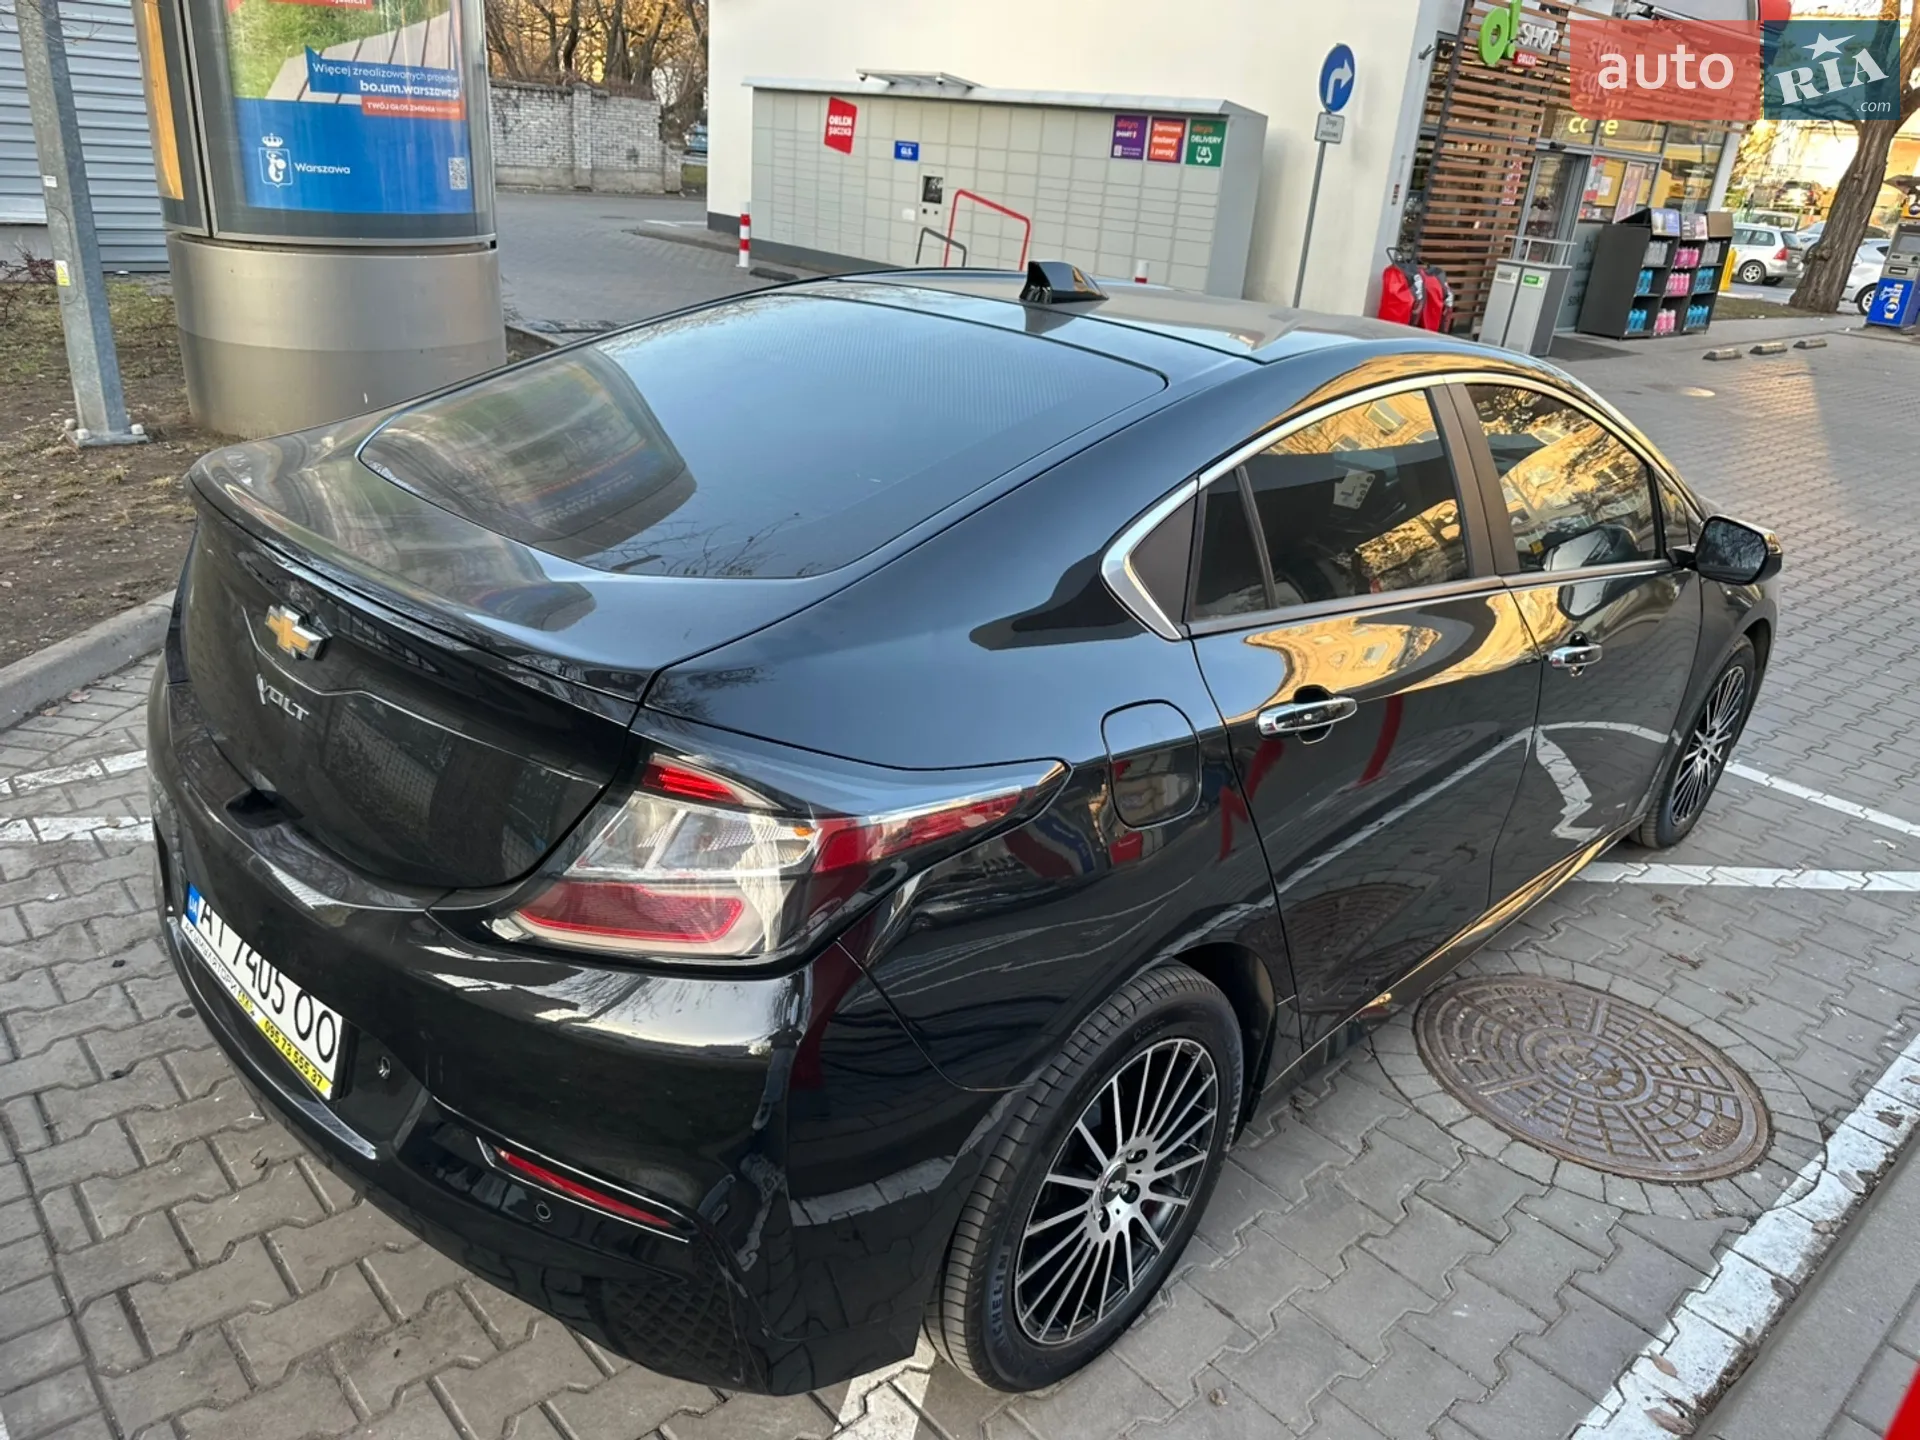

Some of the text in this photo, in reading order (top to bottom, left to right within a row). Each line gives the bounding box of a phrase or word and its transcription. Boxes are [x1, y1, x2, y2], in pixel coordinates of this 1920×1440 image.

[1519, 22, 1560, 55] SHOP
[312, 62, 351, 77] Więcej
[353, 67, 426, 82] zrealizowanych
[360, 79, 460, 100] bo.um.warszawa.pl
[366, 101, 389, 110] TWÓJ
[829, 114, 853, 127] ORLEN
[1190, 134, 1222, 144] DELIVERY
[294, 162, 351, 174] Warszawa
[256, 673, 310, 721] VOLT
[281, 1036, 293, 1057] 73
[293, 1050, 310, 1075] 555
[310, 1068, 323, 1087] 37
